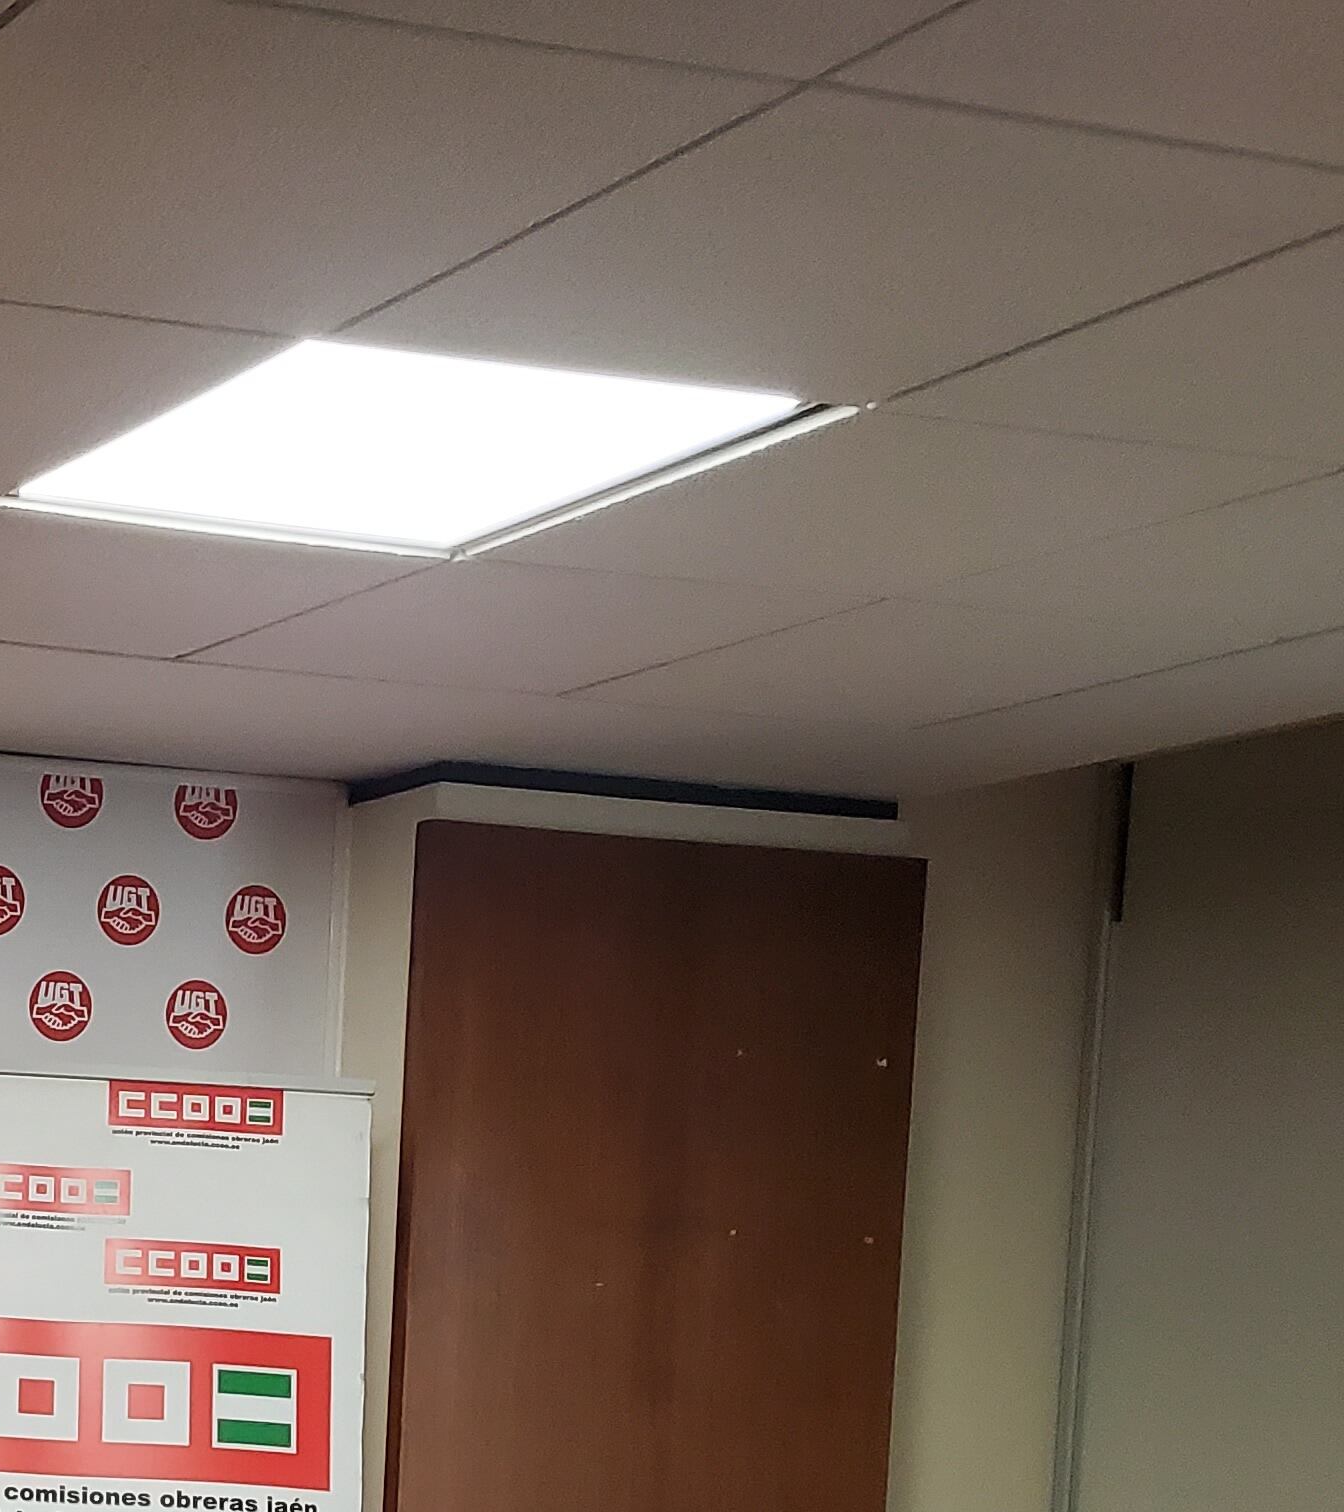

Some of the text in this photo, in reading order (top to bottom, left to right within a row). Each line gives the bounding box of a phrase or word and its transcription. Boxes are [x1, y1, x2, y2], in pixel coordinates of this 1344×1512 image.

[175, 989, 218, 1015] UGT
[116, 1089, 242, 1127] CCOO
[114, 1248, 240, 1284] CCOO
[3, 1484, 152, 1507] comisiones
